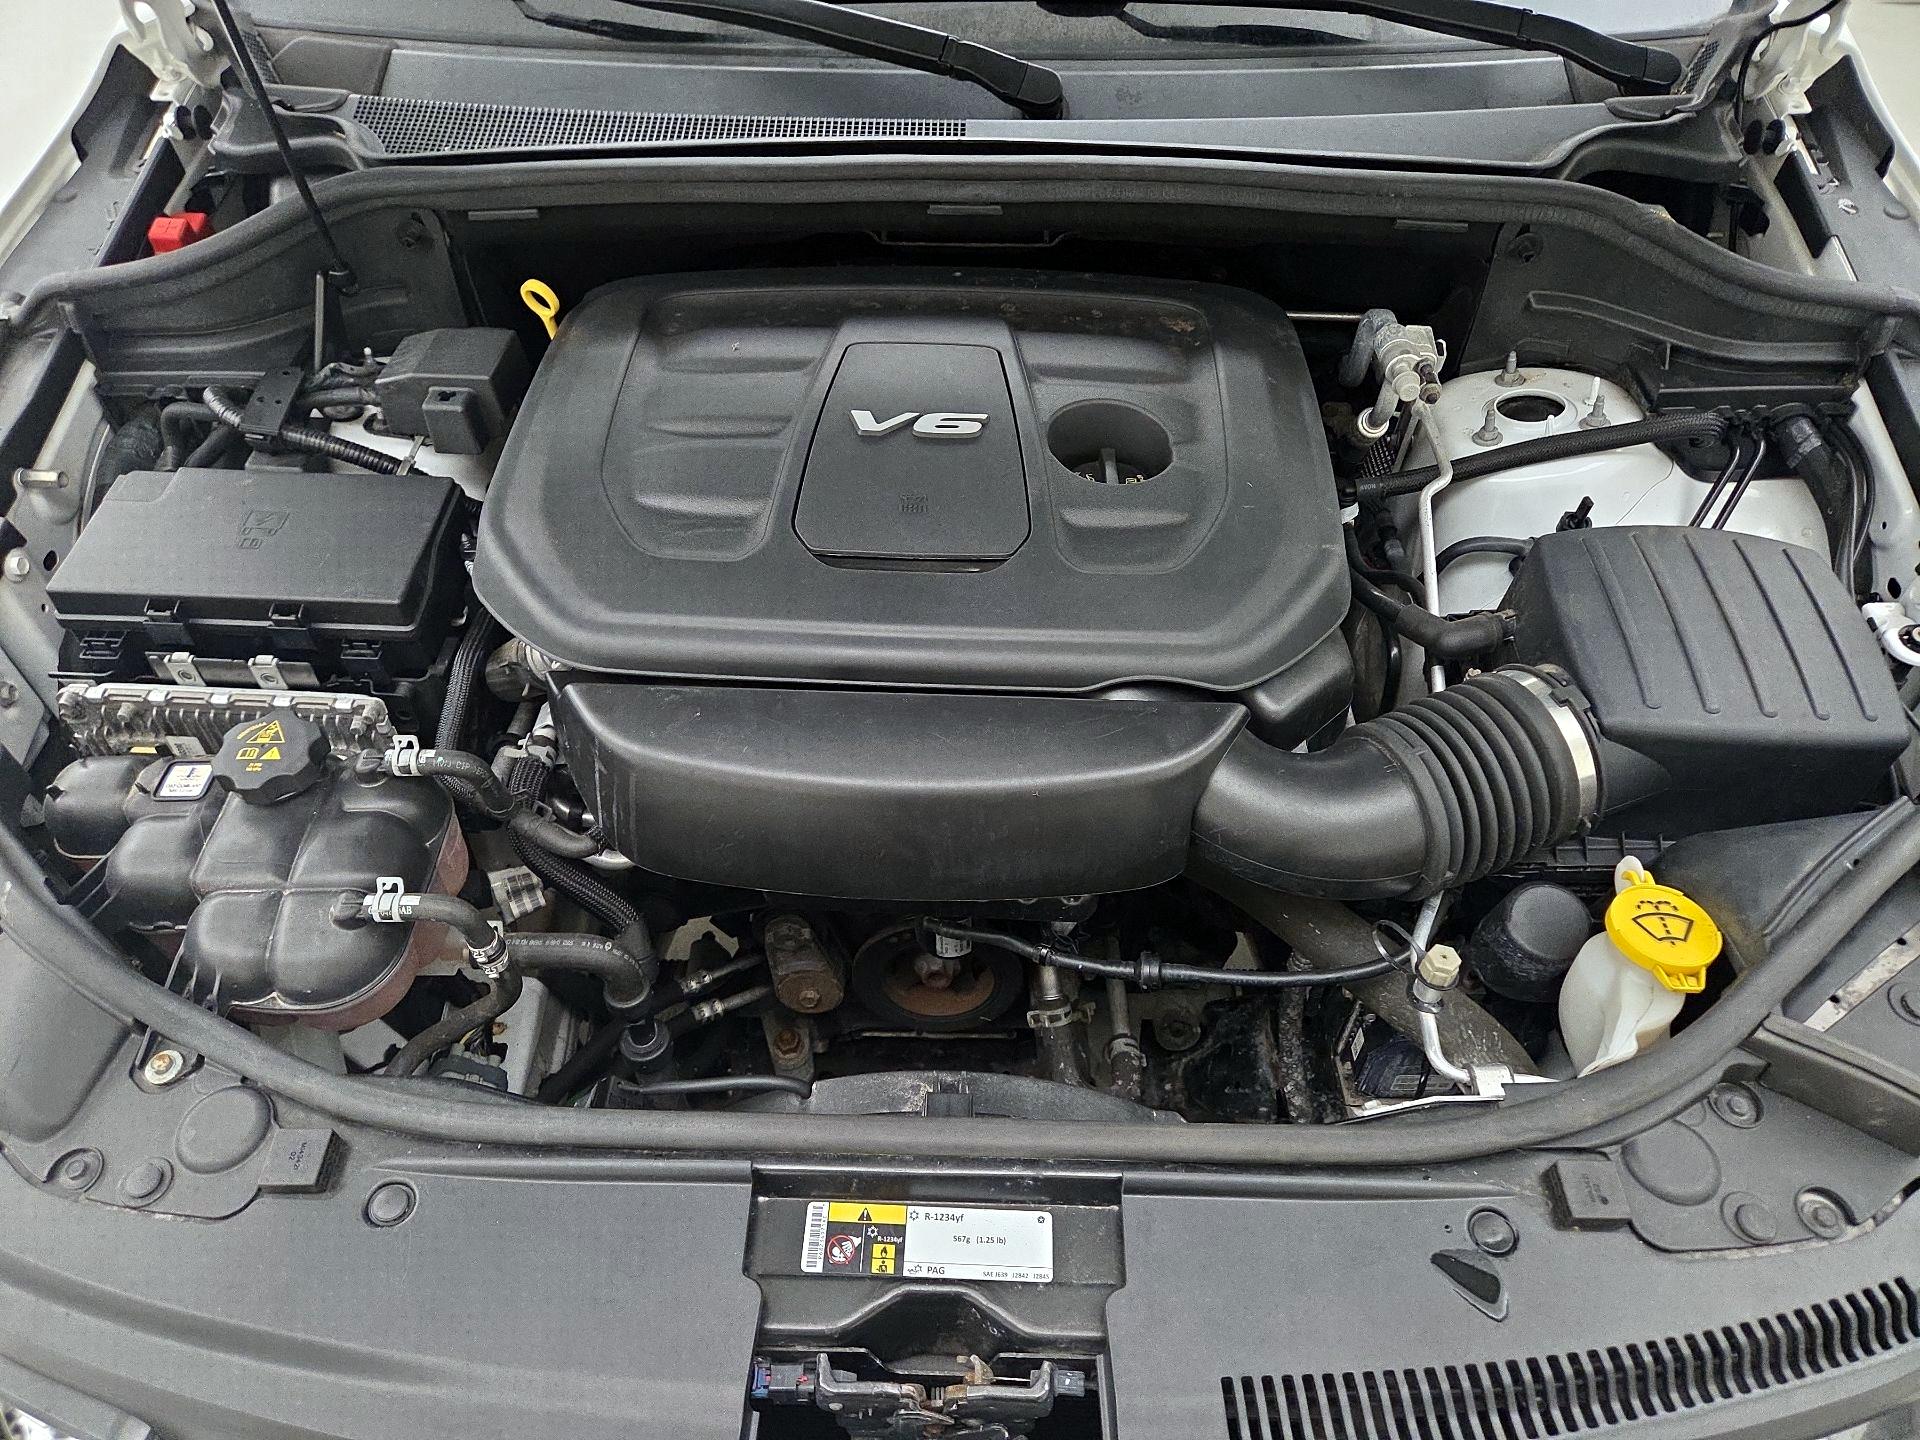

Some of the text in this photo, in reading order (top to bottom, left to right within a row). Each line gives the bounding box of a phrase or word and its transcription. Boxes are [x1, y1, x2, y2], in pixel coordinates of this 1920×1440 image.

[850, 408, 990, 439] V6
[924, 1212, 965, 1224] R-1234yf
[877, 1235, 903, 1244] R-1234yf
[953, 1235, 1007, 1246] 567g (1.25 lb)
[927, 1266, 945, 1275] PAG
[995, 1271, 1008, 1279] J639
